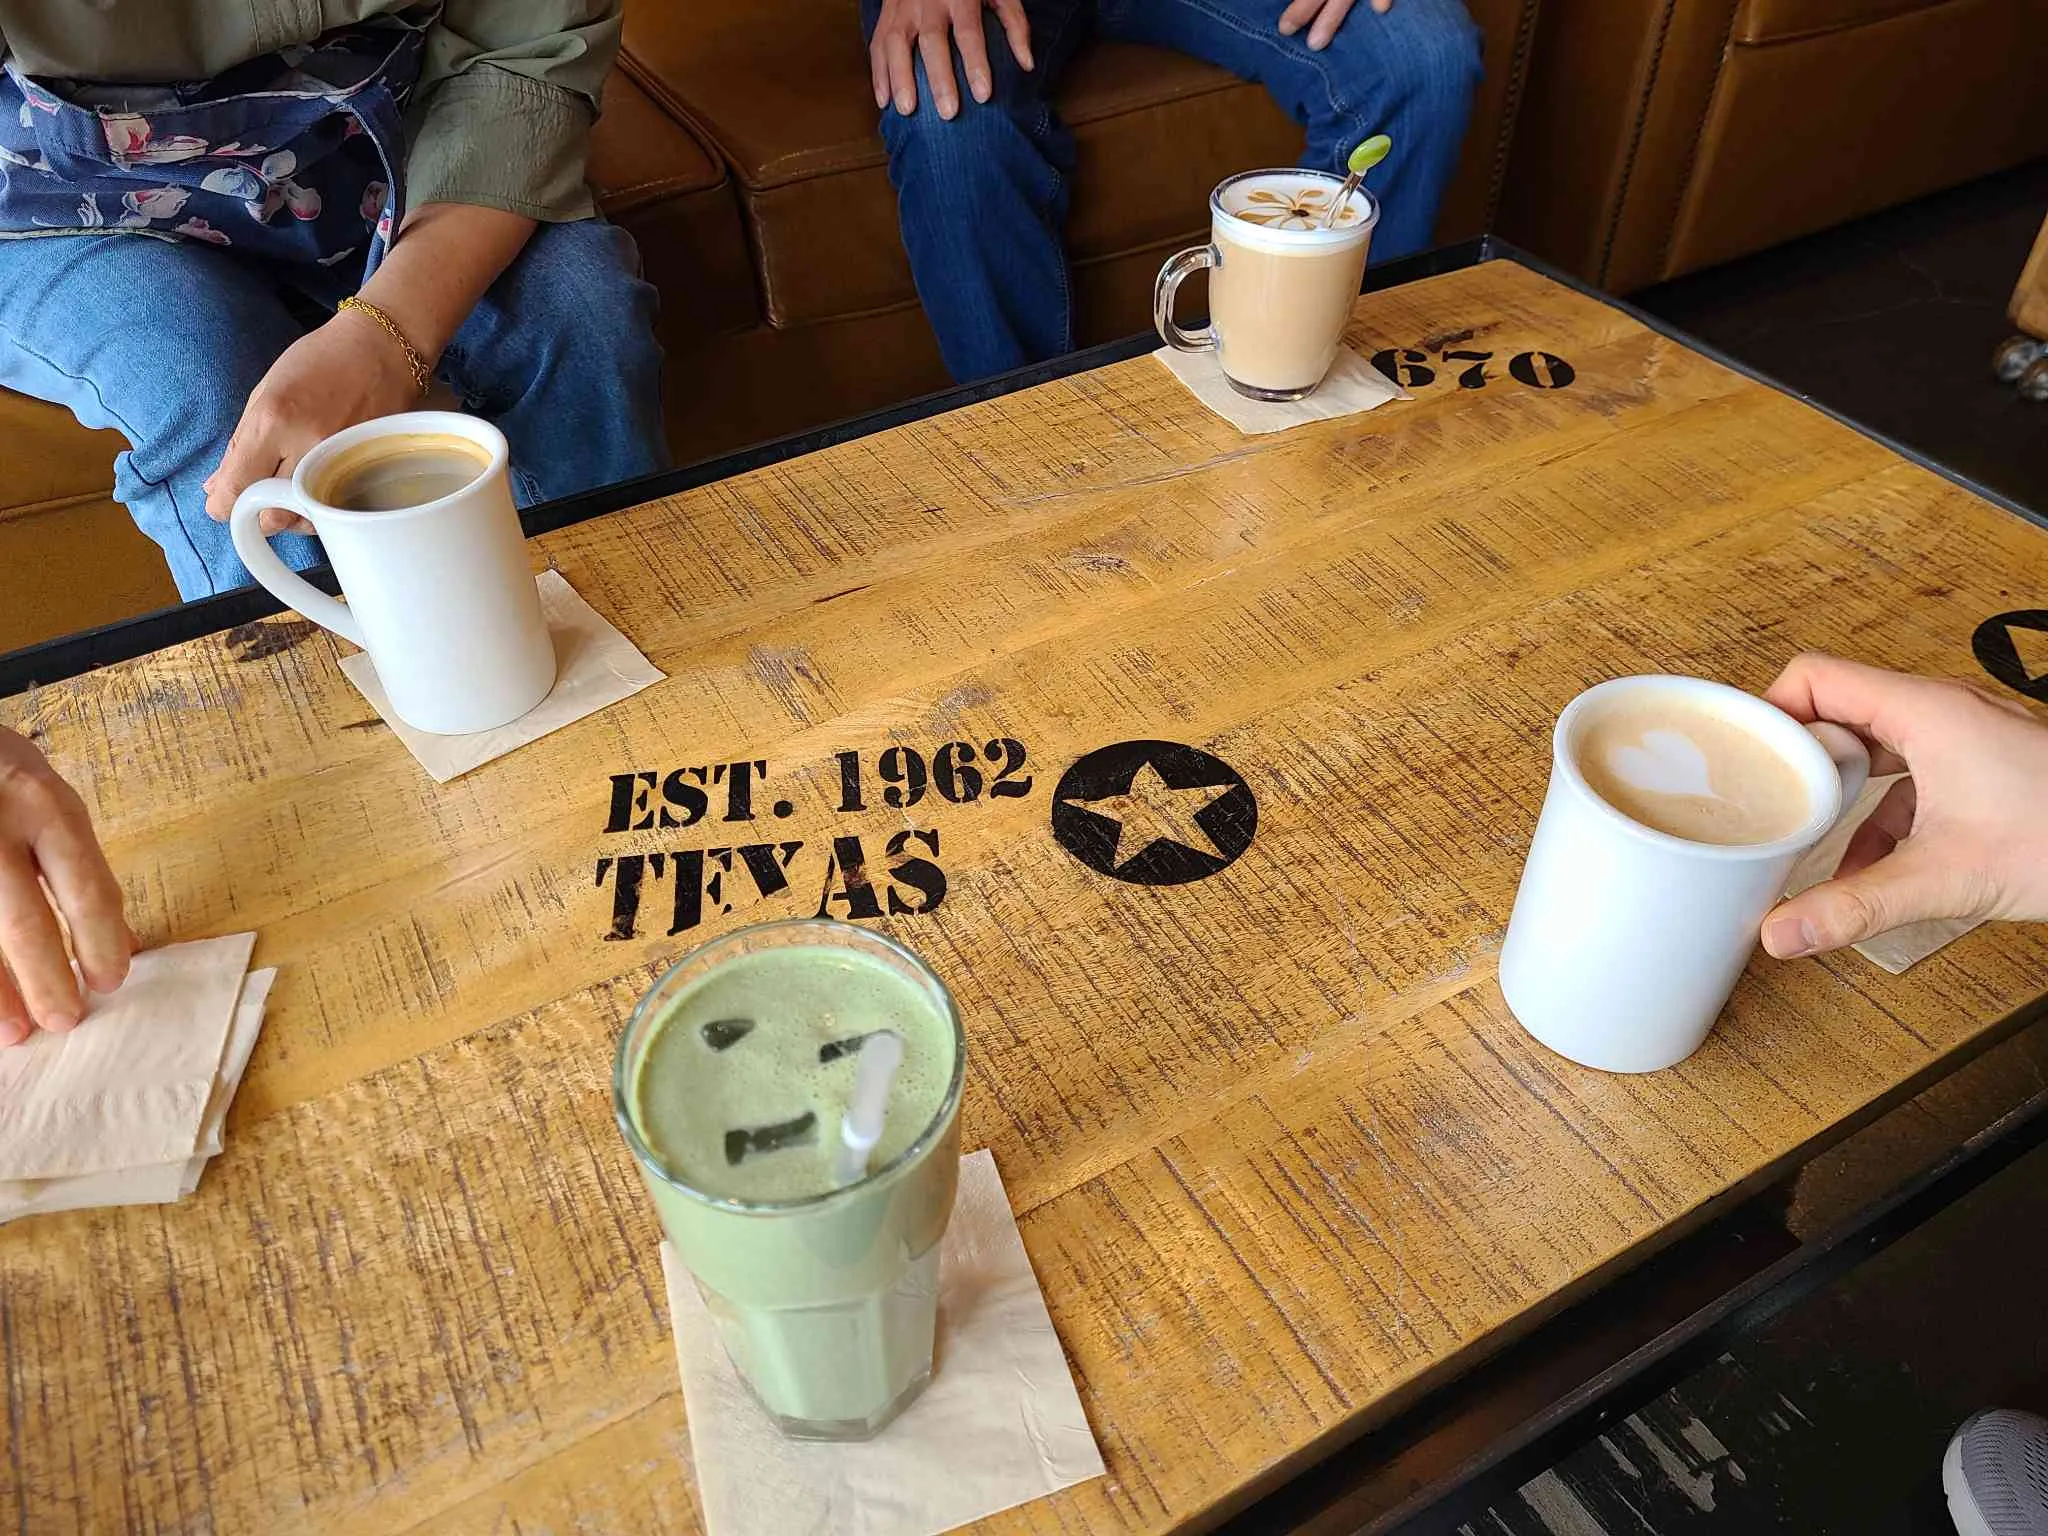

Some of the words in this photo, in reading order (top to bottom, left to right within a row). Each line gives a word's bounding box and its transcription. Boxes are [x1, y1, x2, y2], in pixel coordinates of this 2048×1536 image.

[1371, 349, 1576, 389] 670
[603, 760, 794, 833] EST.
[836, 739, 1033, 813] 1962
